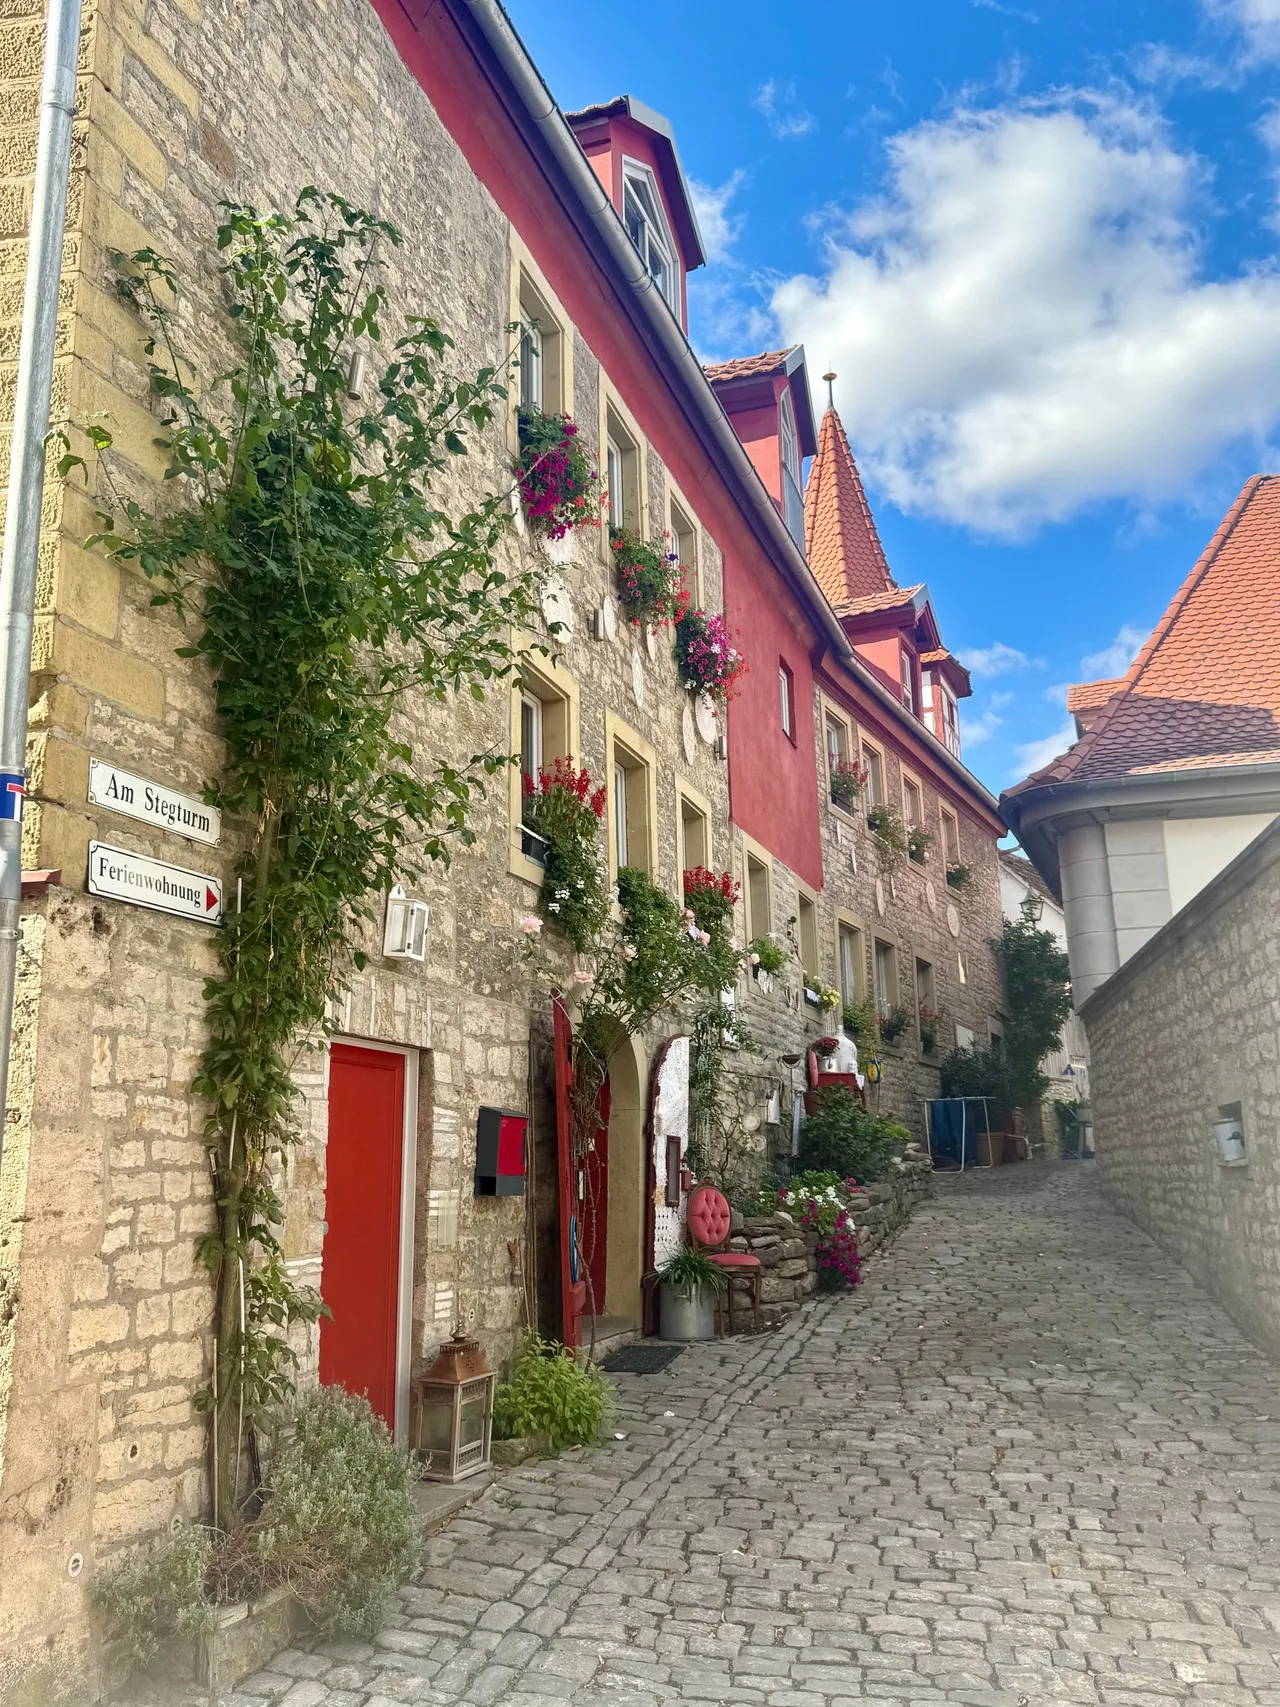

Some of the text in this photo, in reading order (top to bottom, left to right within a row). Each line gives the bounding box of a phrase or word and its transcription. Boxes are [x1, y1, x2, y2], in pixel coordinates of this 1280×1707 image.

[105, 772, 210, 833] Am Stegturm
[98, 856, 201, 908] Ferienwohnung
